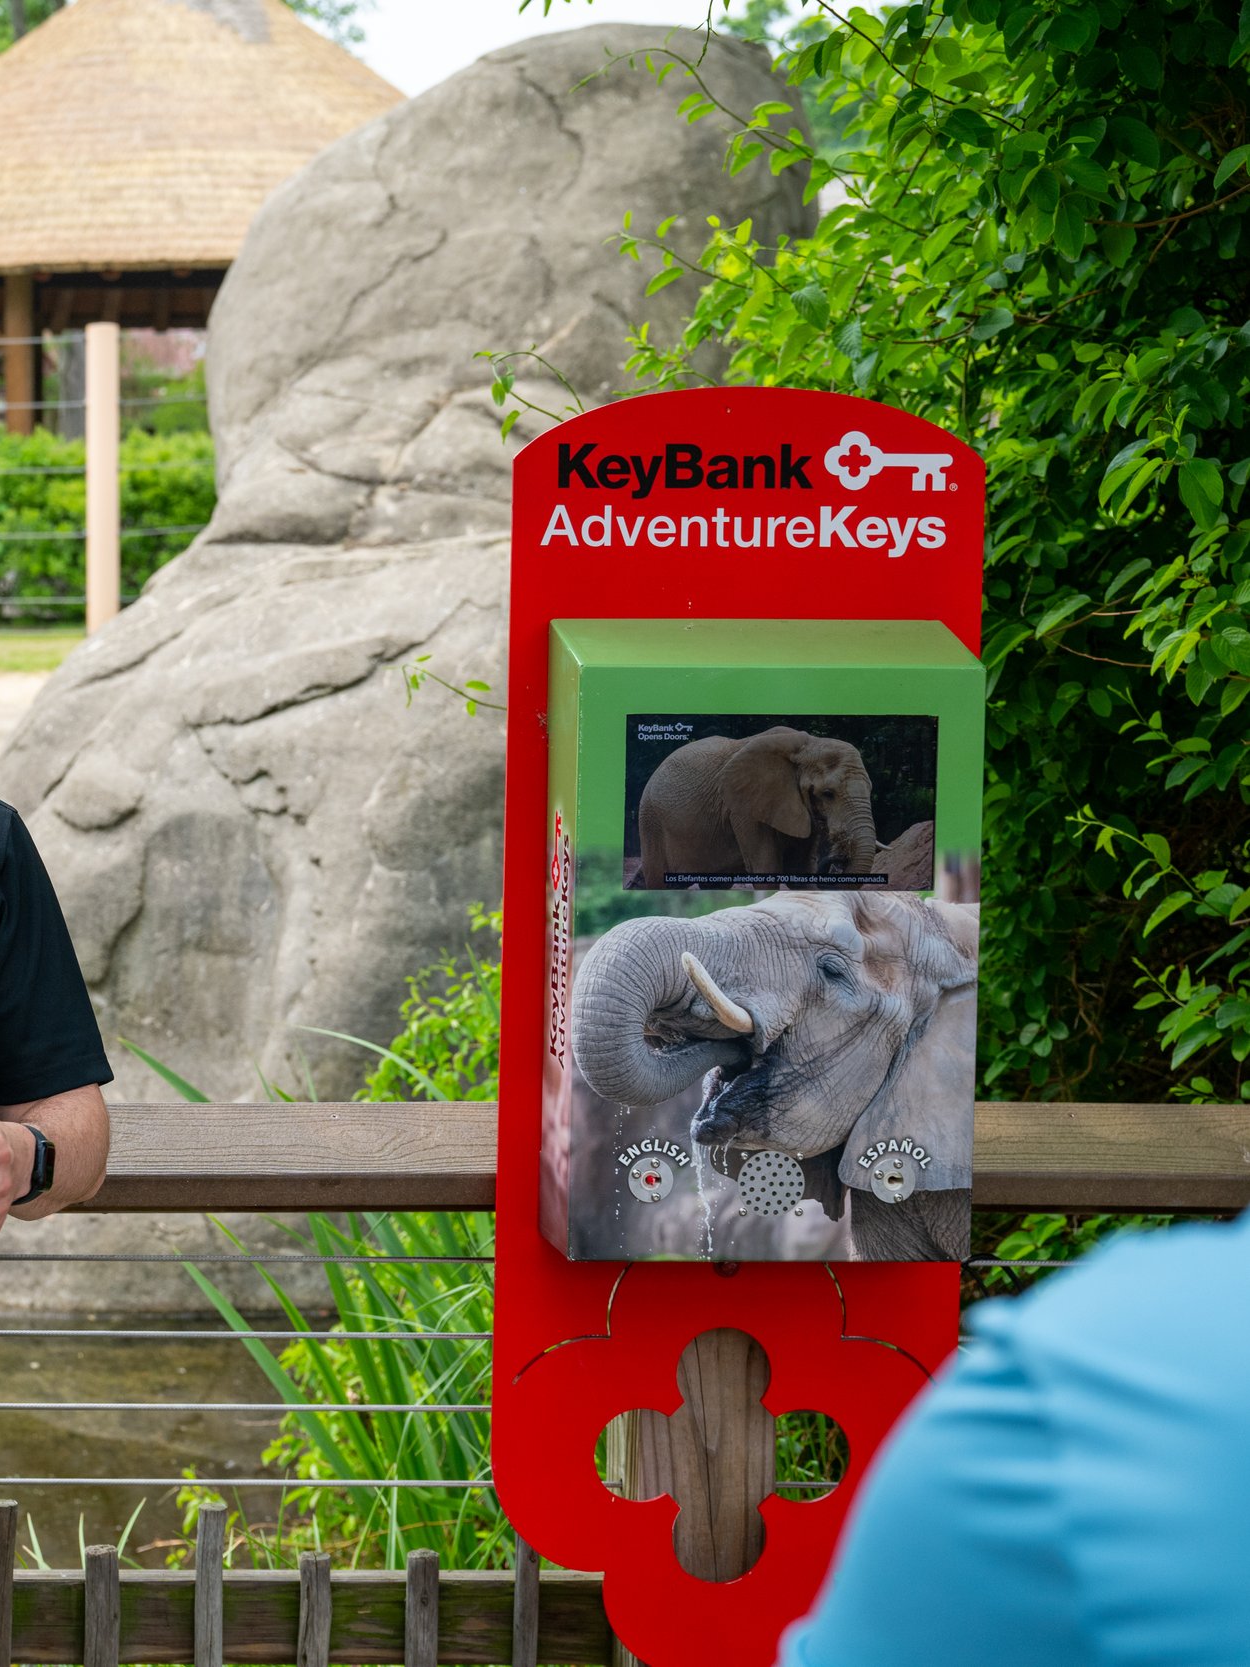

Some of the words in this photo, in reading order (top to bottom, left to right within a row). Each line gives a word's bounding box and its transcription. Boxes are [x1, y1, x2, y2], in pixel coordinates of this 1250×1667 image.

[557, 443, 813, 499] KeyBank
[540, 504, 946, 558] AdventureKeys
[637, 733, 663, 741] Opens
[638, 724, 674, 733] KeyBank
[857, 875, 887, 883] manada.
[557, 834, 570, 1071] AdventureKeys
[549, 900, 561, 1056] KeyBank
[618, 1139, 690, 1167] ENGLISH
[858, 1138, 931, 1169] ESPAÑOL
